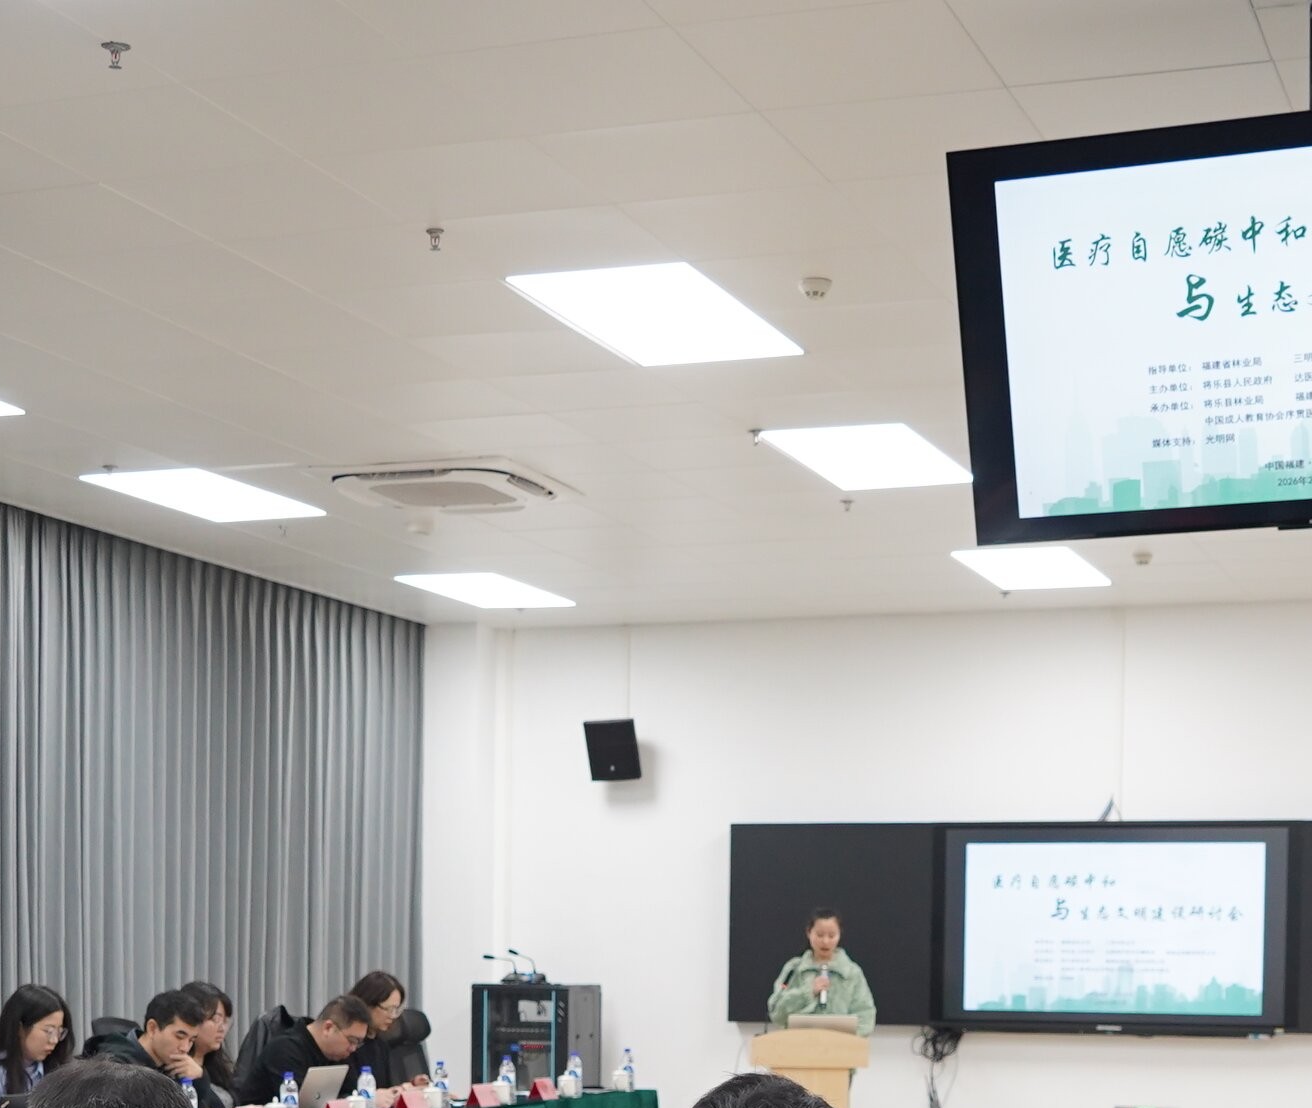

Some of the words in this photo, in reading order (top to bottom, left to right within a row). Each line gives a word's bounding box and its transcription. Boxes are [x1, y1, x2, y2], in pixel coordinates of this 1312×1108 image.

[1052, 215, 1308, 270] 医疗自愿碳中和
[1202, 357, 1263, 371] 福建省林业局
[1203, 375, 1273, 390] 将乐县人民政府
[1203, 395, 1264, 409] 将乐县林业局
[1205, 433, 1236, 445] 光明网
